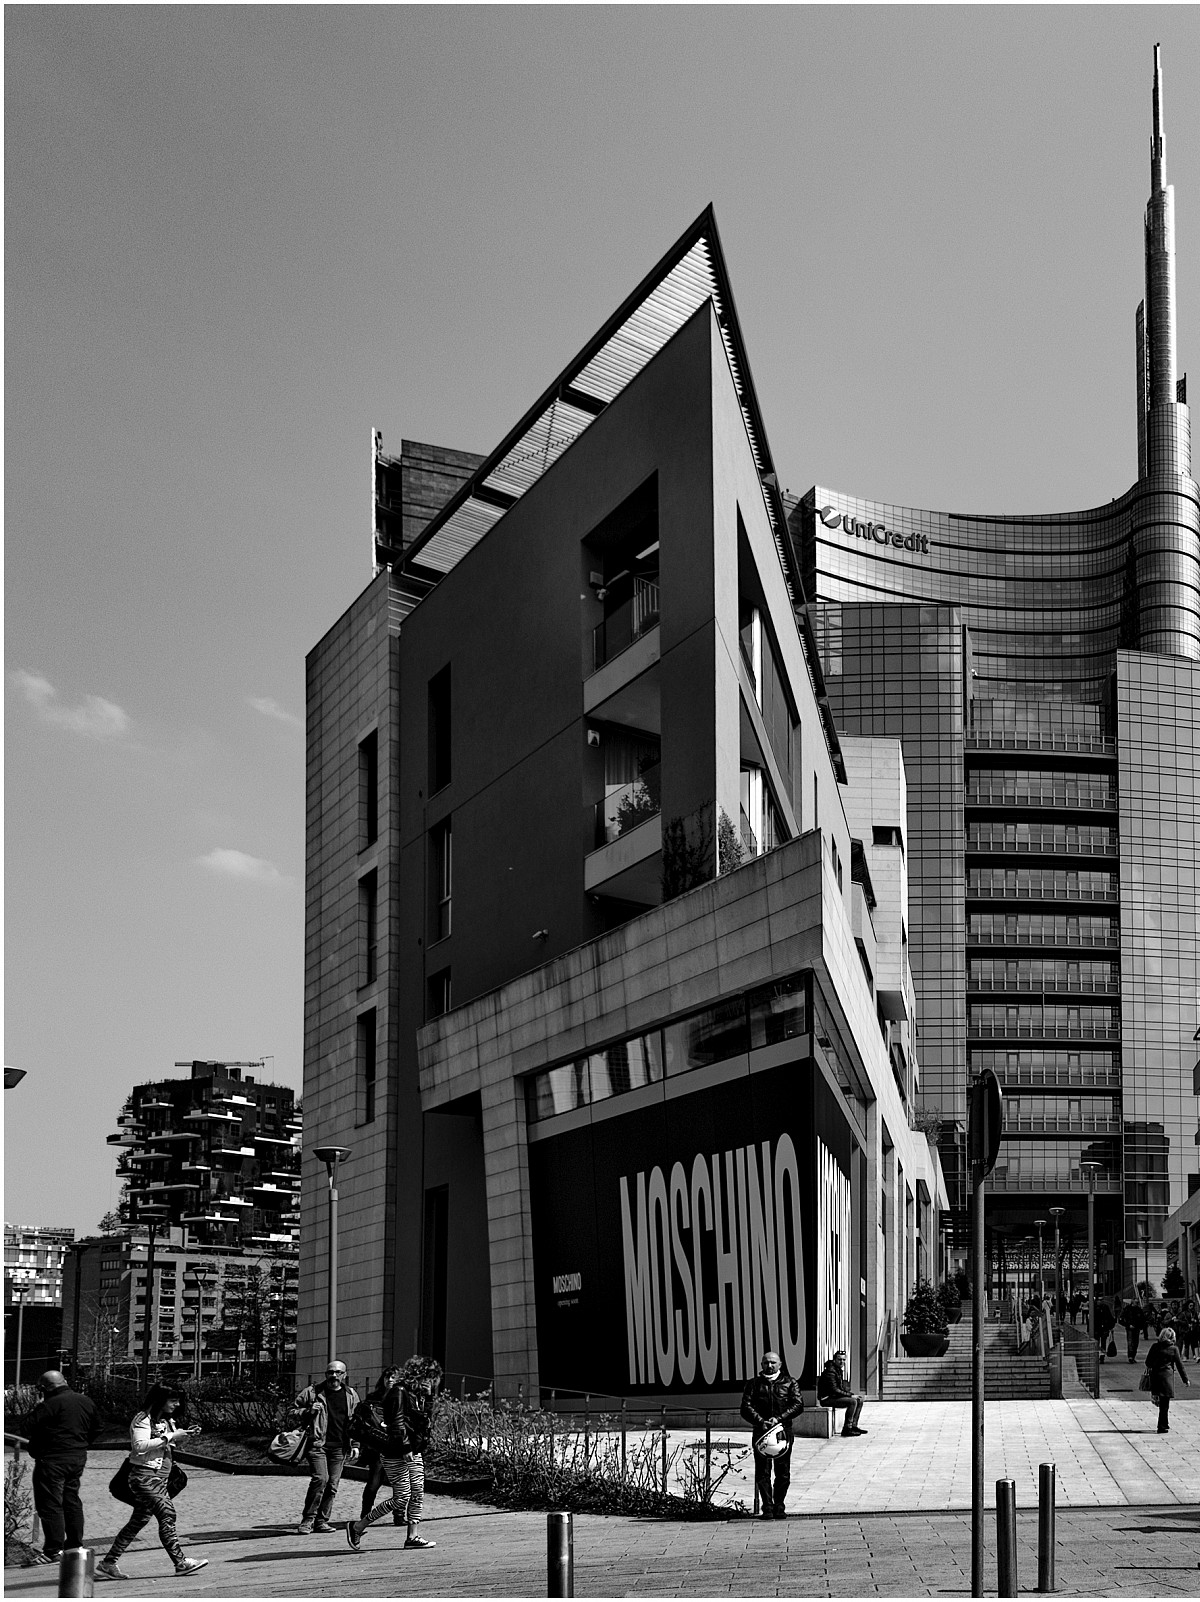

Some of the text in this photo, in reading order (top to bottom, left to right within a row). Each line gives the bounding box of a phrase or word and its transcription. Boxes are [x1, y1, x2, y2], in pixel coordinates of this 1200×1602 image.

[843, 515, 929, 554] UniCredit
[620, 1133, 807, 1386] MOSCHINO
[553, 1272, 582, 1294] MOSCHINO
